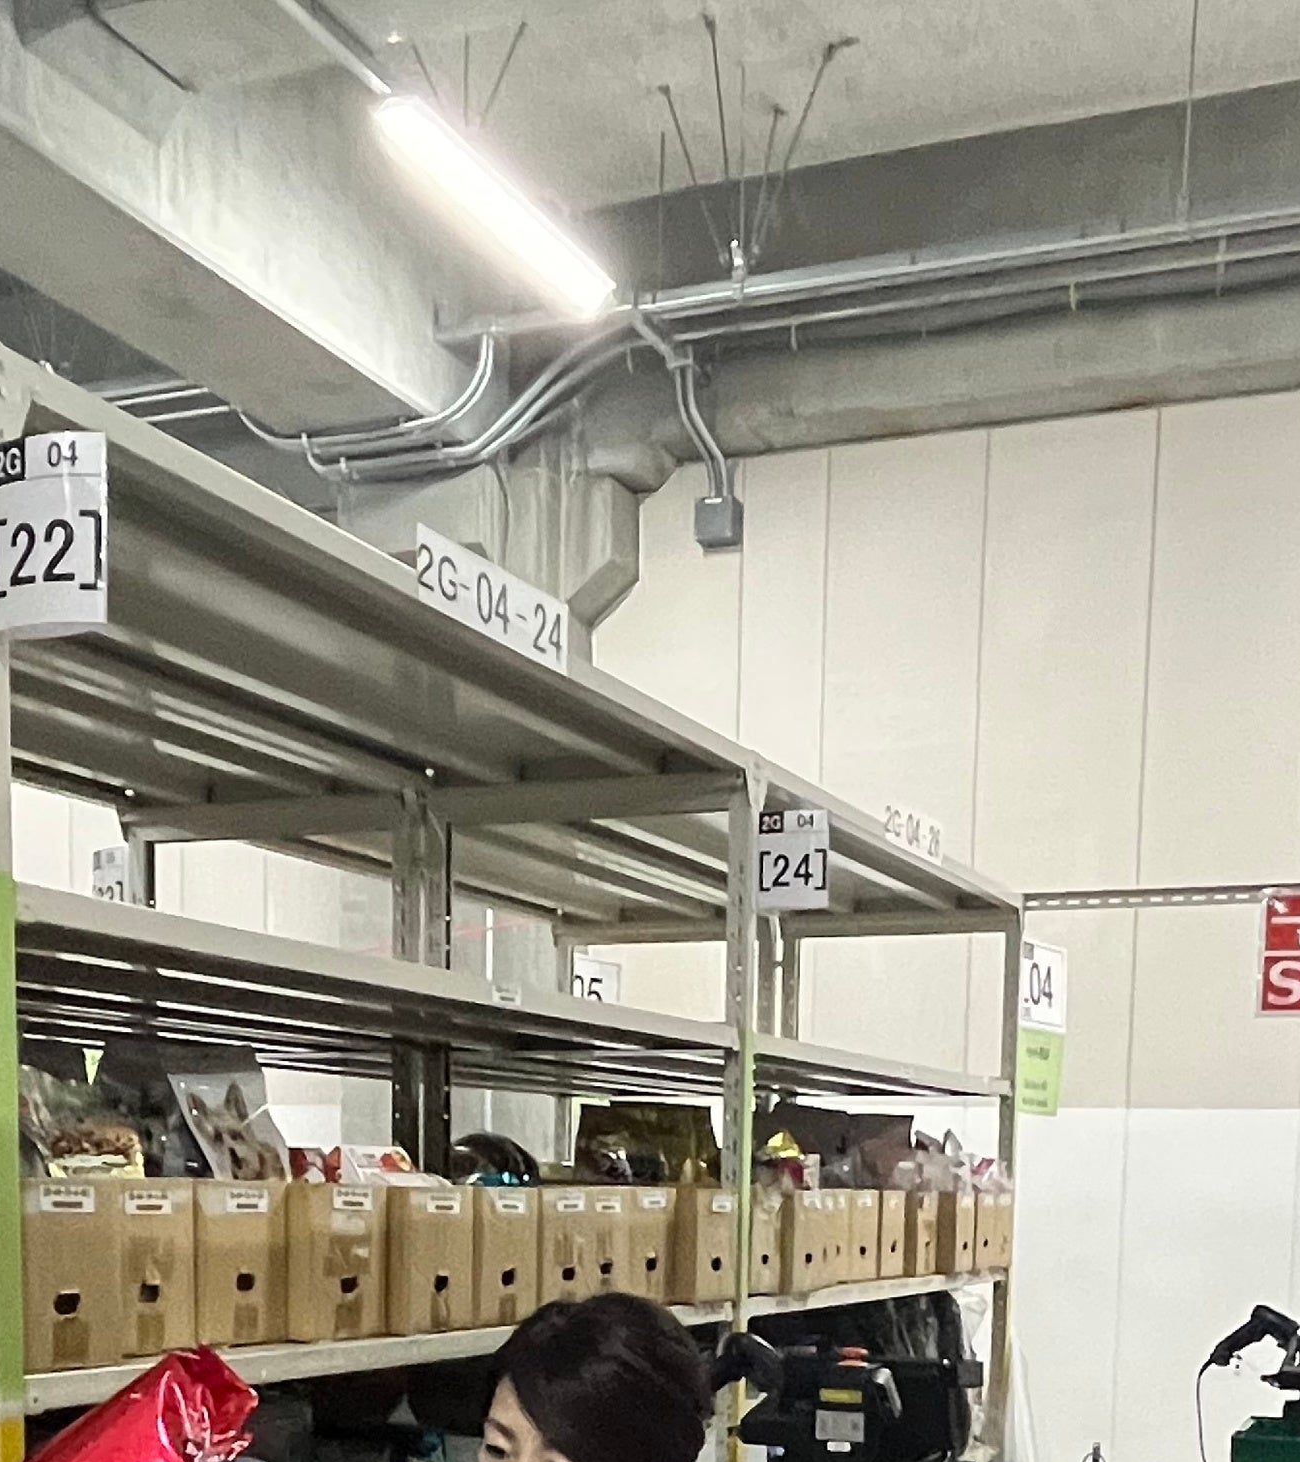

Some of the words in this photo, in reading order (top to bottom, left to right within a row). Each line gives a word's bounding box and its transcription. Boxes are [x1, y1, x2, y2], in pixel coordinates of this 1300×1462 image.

[47, 439, 78, 468] 04
[417, 543, 563, 661] 2G-04-24
[759, 848, 827, 891] [24]
